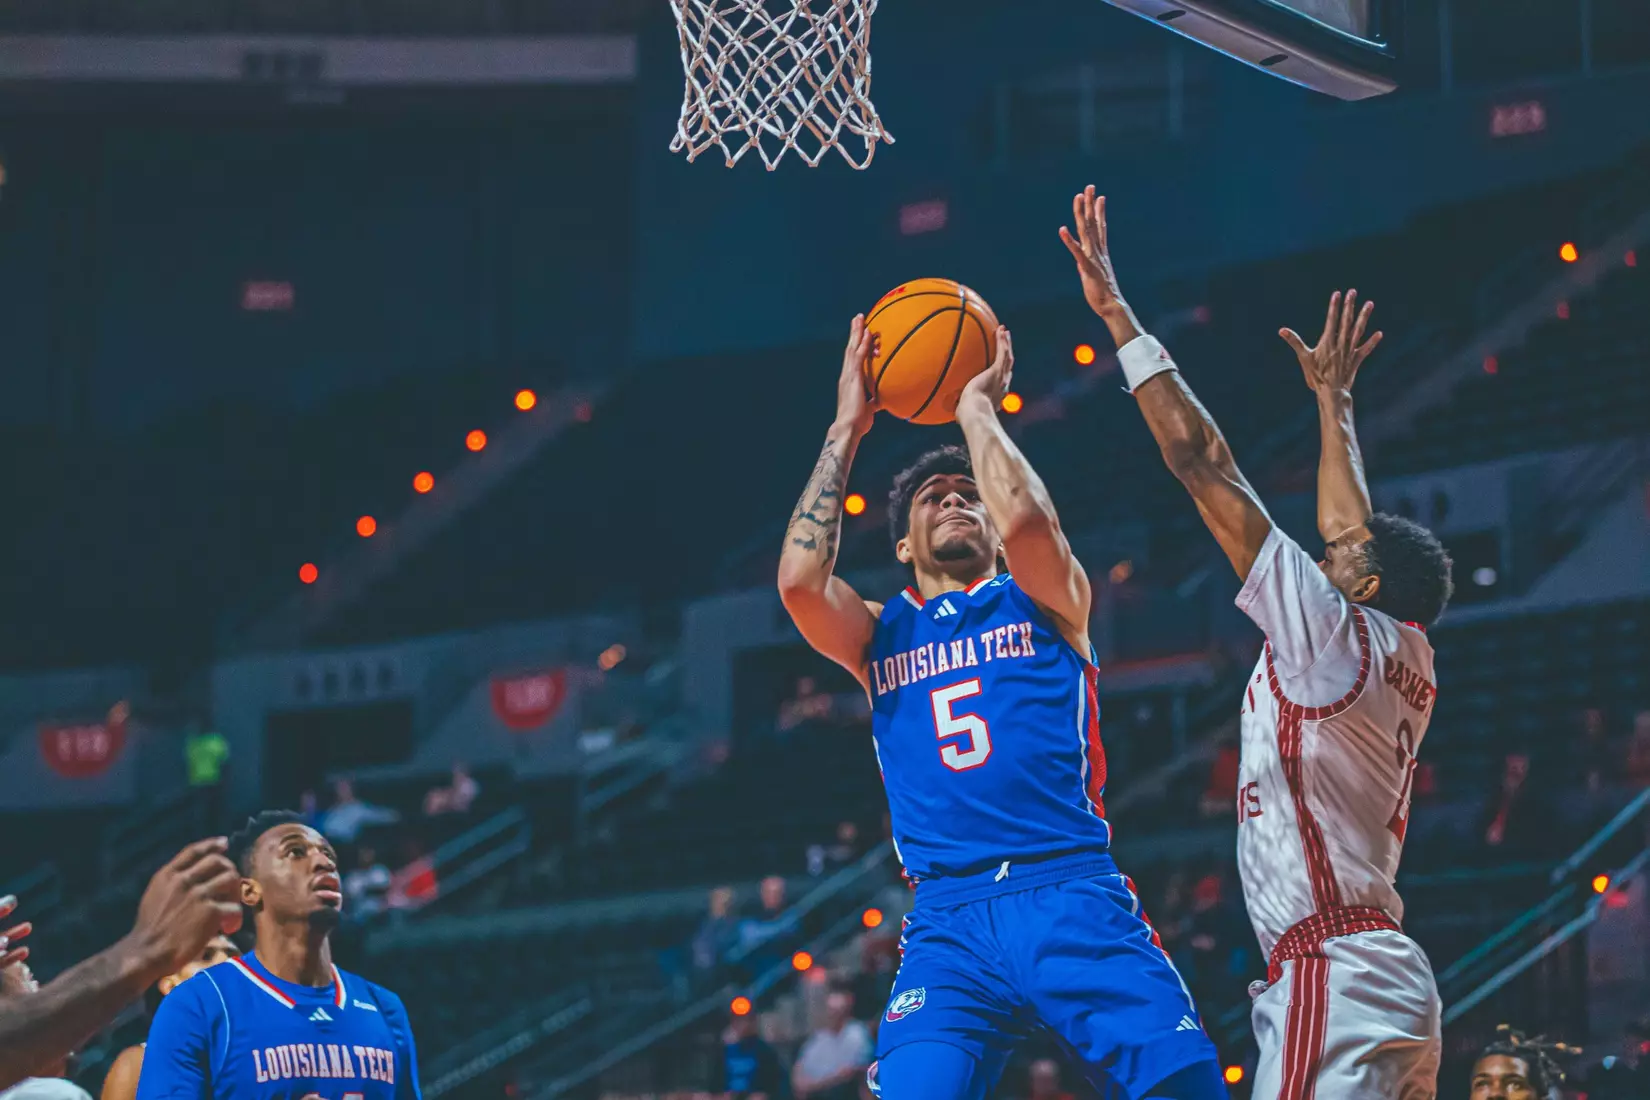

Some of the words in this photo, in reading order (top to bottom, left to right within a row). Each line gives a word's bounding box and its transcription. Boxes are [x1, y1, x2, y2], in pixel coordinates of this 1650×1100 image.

[872, 637, 979, 696] LOUISIANA
[980, 621, 1036, 663] TECH
[930, 677, 992, 772] 5
[252, 1043, 355, 1083] LOUISIANA
[353, 1045, 394, 1085] TECH
